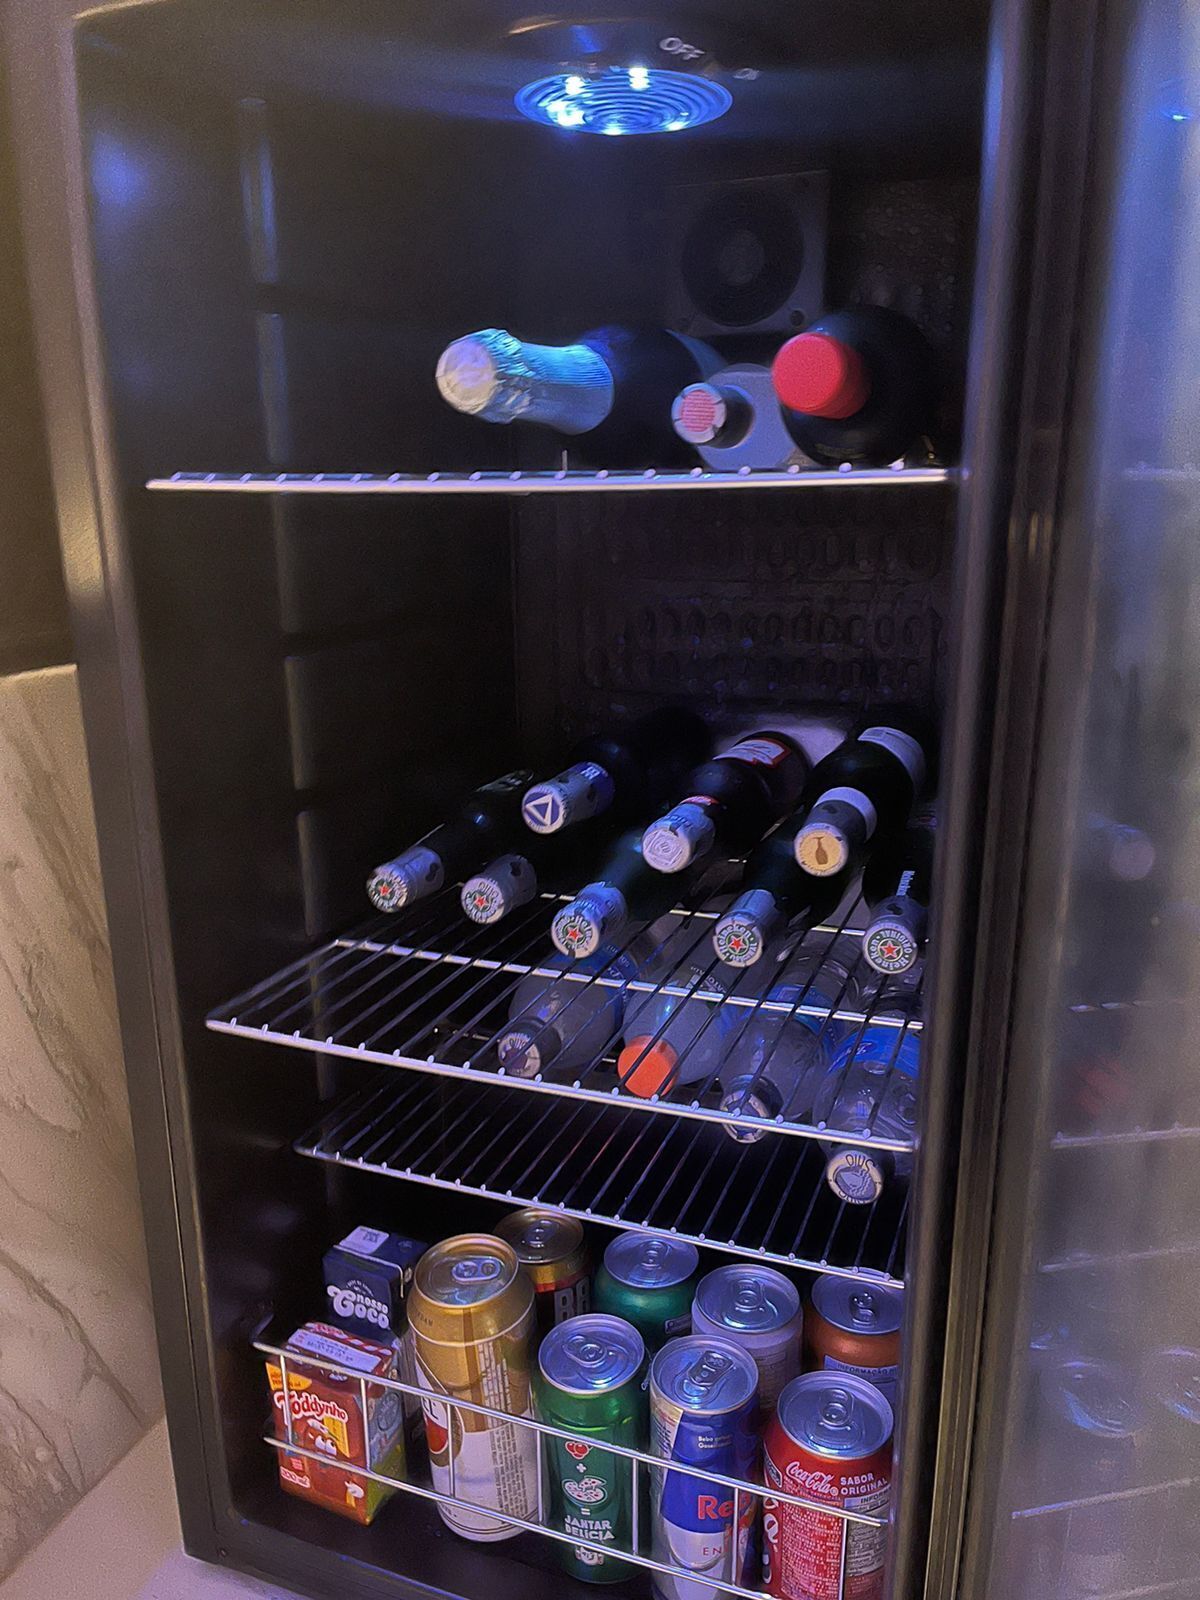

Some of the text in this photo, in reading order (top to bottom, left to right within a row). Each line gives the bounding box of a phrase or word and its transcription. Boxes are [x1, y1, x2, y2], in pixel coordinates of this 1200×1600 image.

[879, 929, 913, 954] ORIGINAL
[870, 939, 910, 971] Heineken
[274, 1391, 348, 1424] Toddynho
[840, 1473, 874, 1486] SABOR
[840, 1479, 888, 1496] ORIGINAL
[564, 1514, 613, 1531] JANTAR
